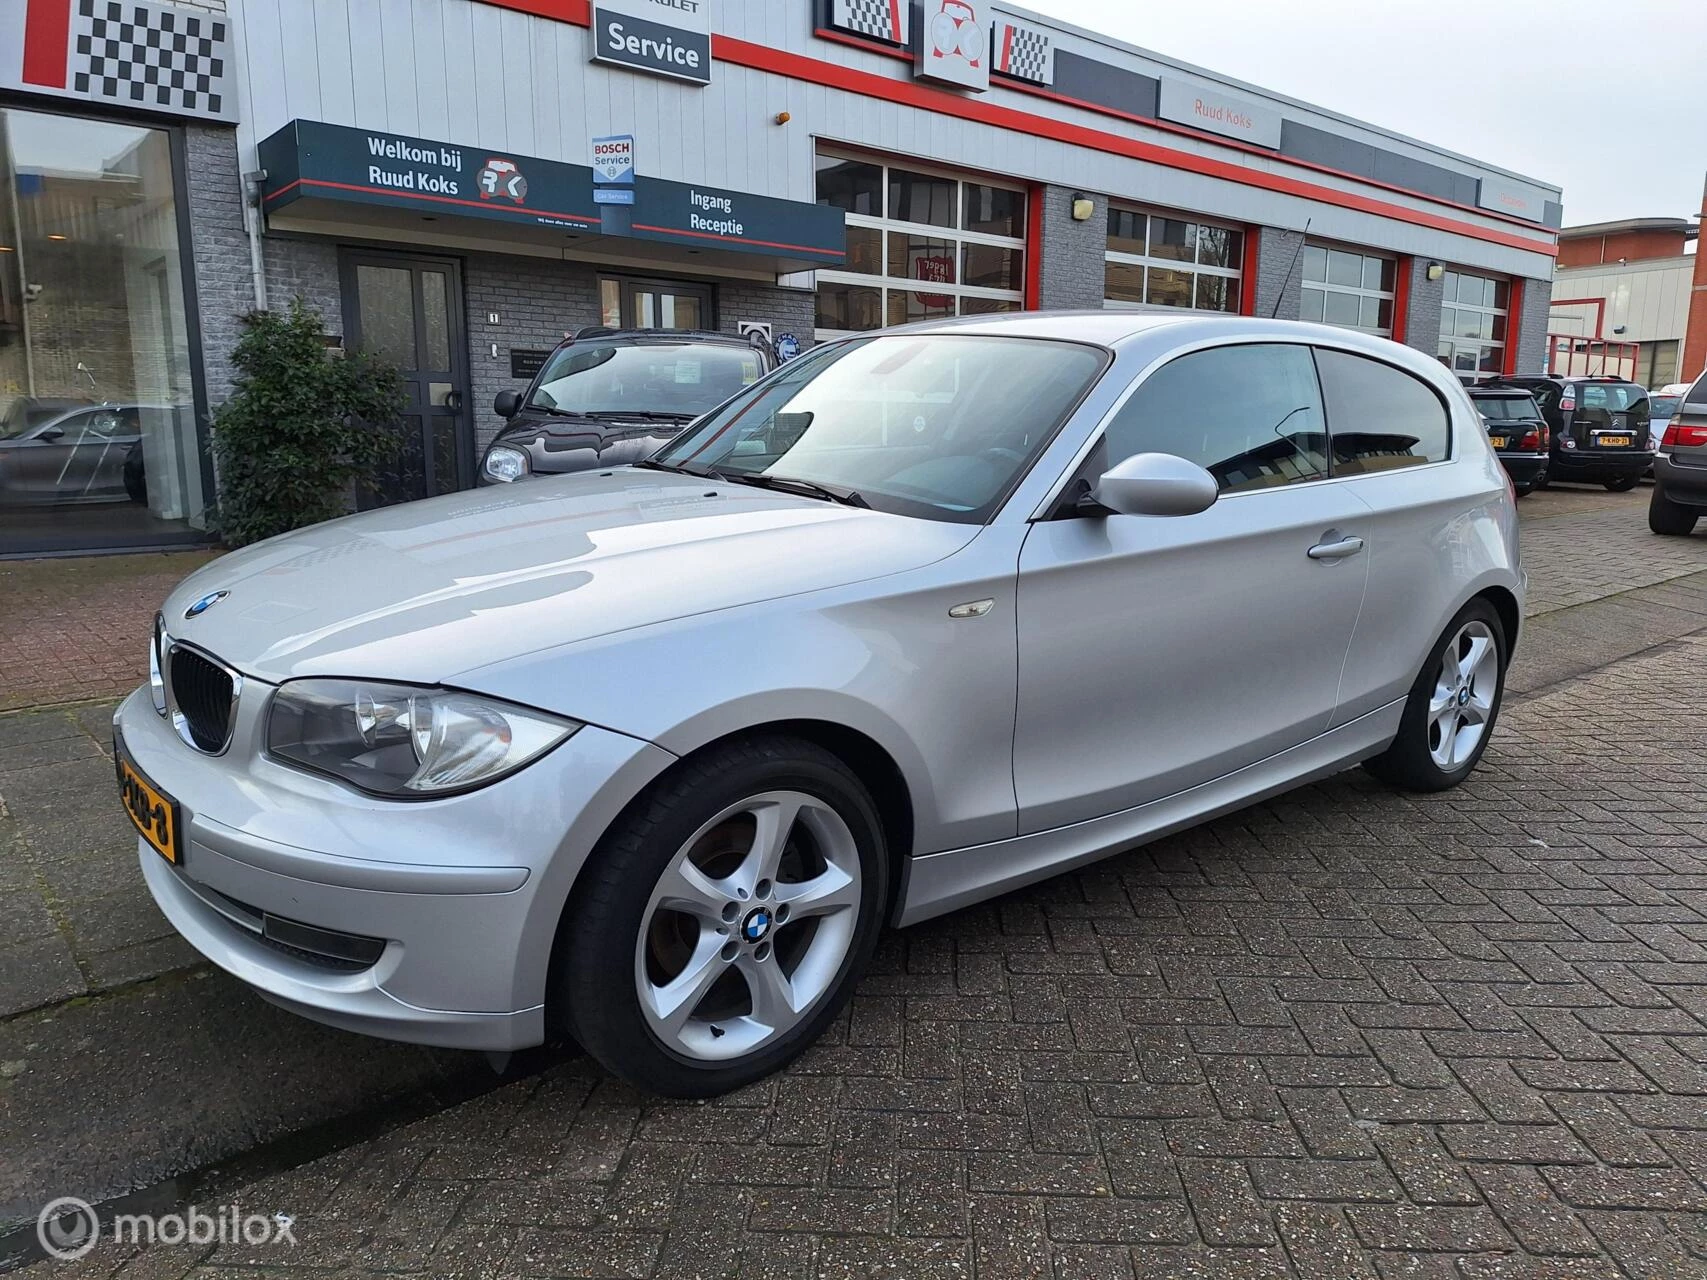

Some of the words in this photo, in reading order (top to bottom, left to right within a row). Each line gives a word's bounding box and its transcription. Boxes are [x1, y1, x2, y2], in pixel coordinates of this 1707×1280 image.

[608, 22, 699, 68] Service
[1195, 99, 1223, 121] Ruud
[1226, 108, 1252, 129] Koks
[367, 137, 437, 165] Welkom
[441, 148, 461, 172] bij
[594, 143, 630, 155] BOSCH
[594, 155, 630, 165] Service
[368, 165, 414, 189] Ruud
[418, 172, 459, 195] Koks
[690, 189, 732, 214] Ingang
[690, 213, 743, 236] Receptie
